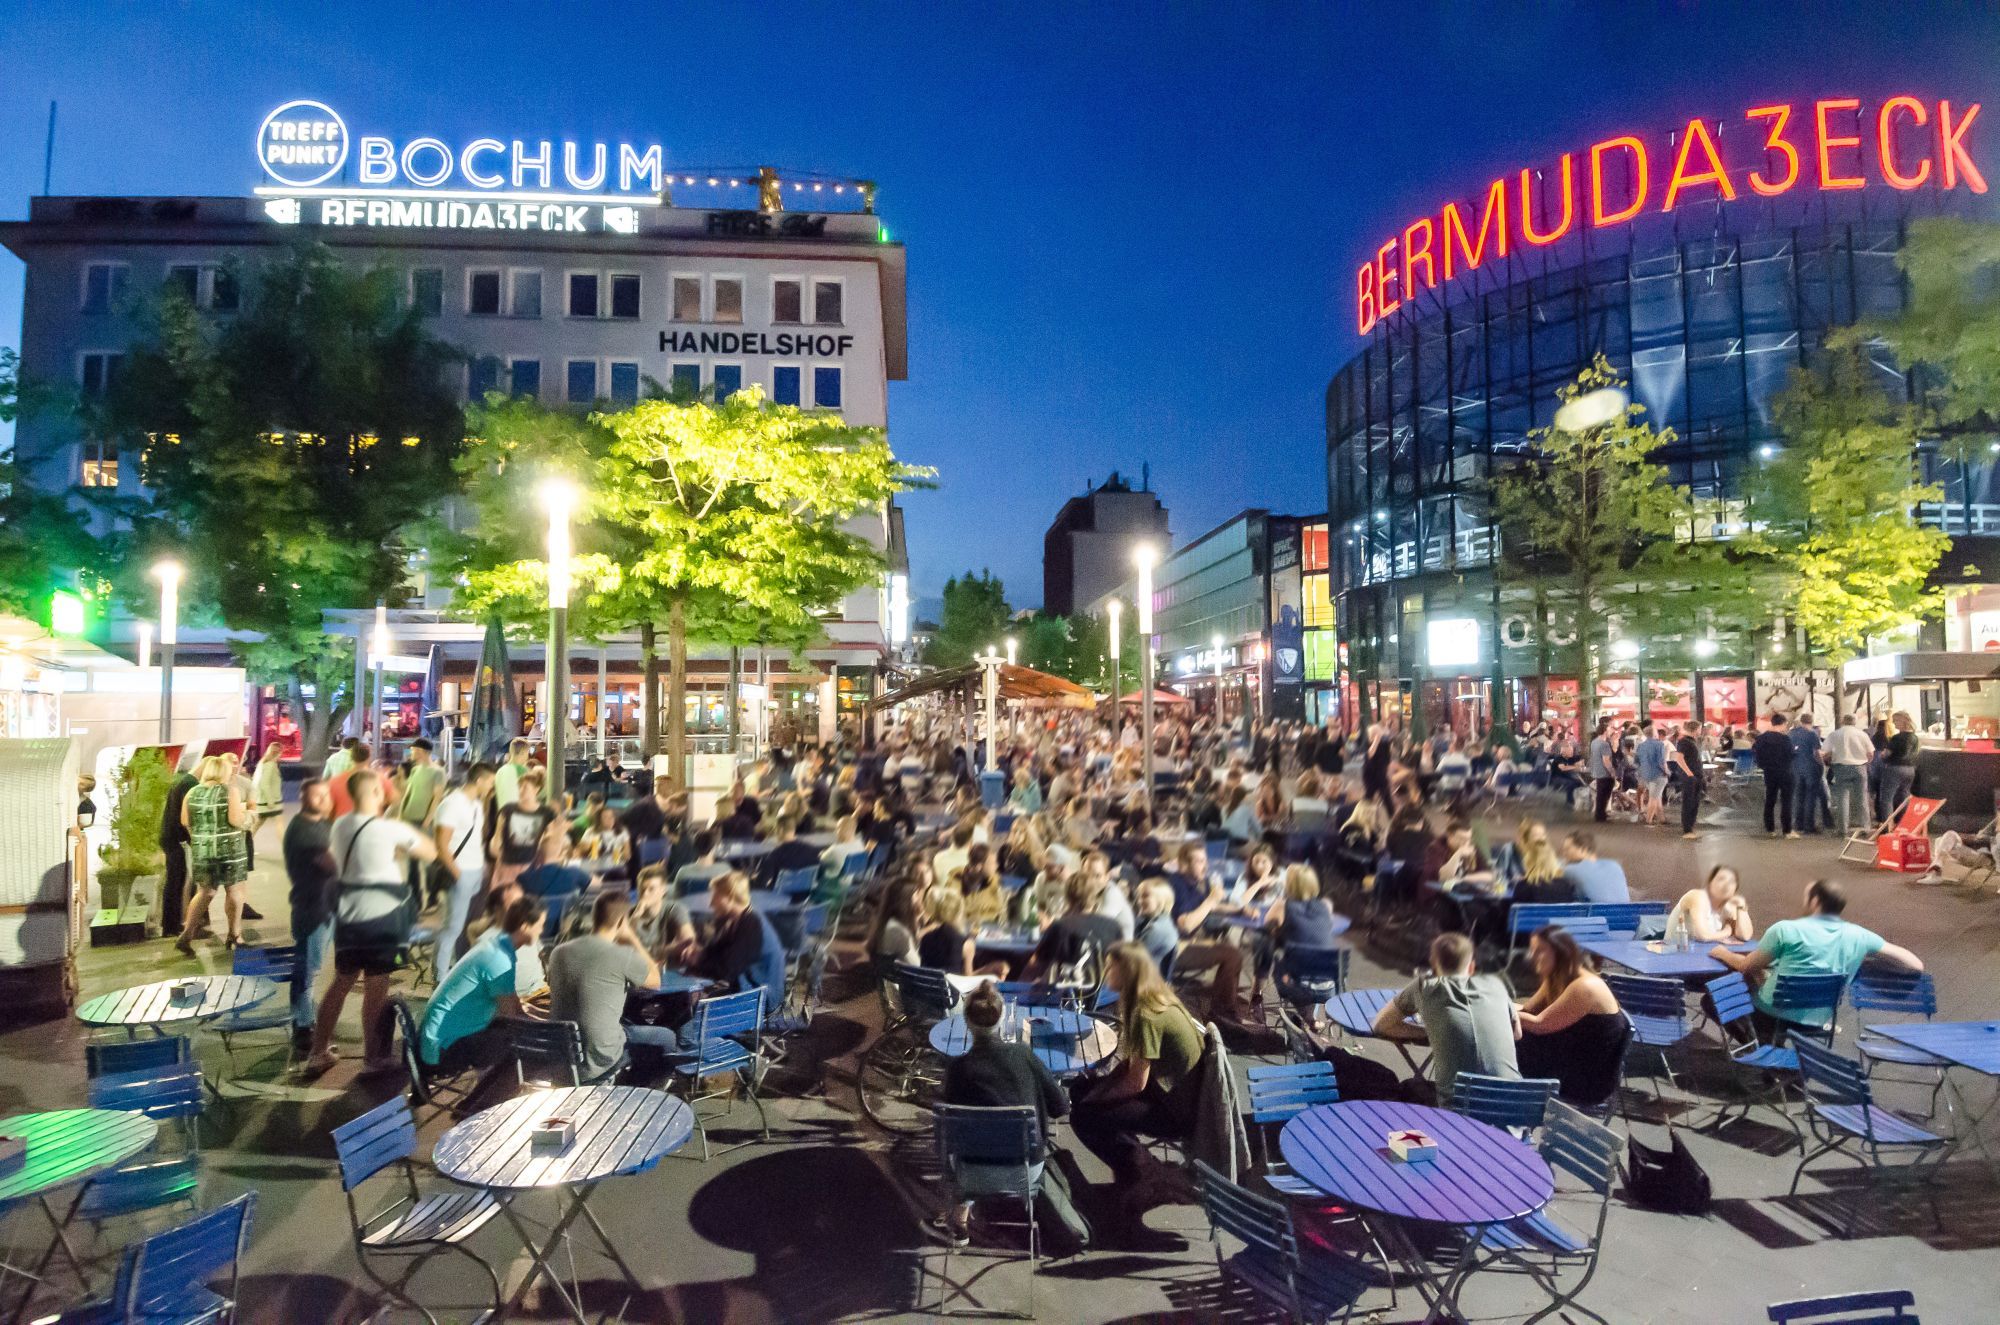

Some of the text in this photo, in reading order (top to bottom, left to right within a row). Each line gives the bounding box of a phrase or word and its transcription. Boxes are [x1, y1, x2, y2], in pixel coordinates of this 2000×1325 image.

[269, 121, 340, 142] TREFF
[267, 144, 339, 165] PUNKT
[359, 136, 662, 192] BOCHUM
[1358, 97, 1987, 335] BERMUDA3ECK
[659, 331, 854, 356] HANDELSHOF
